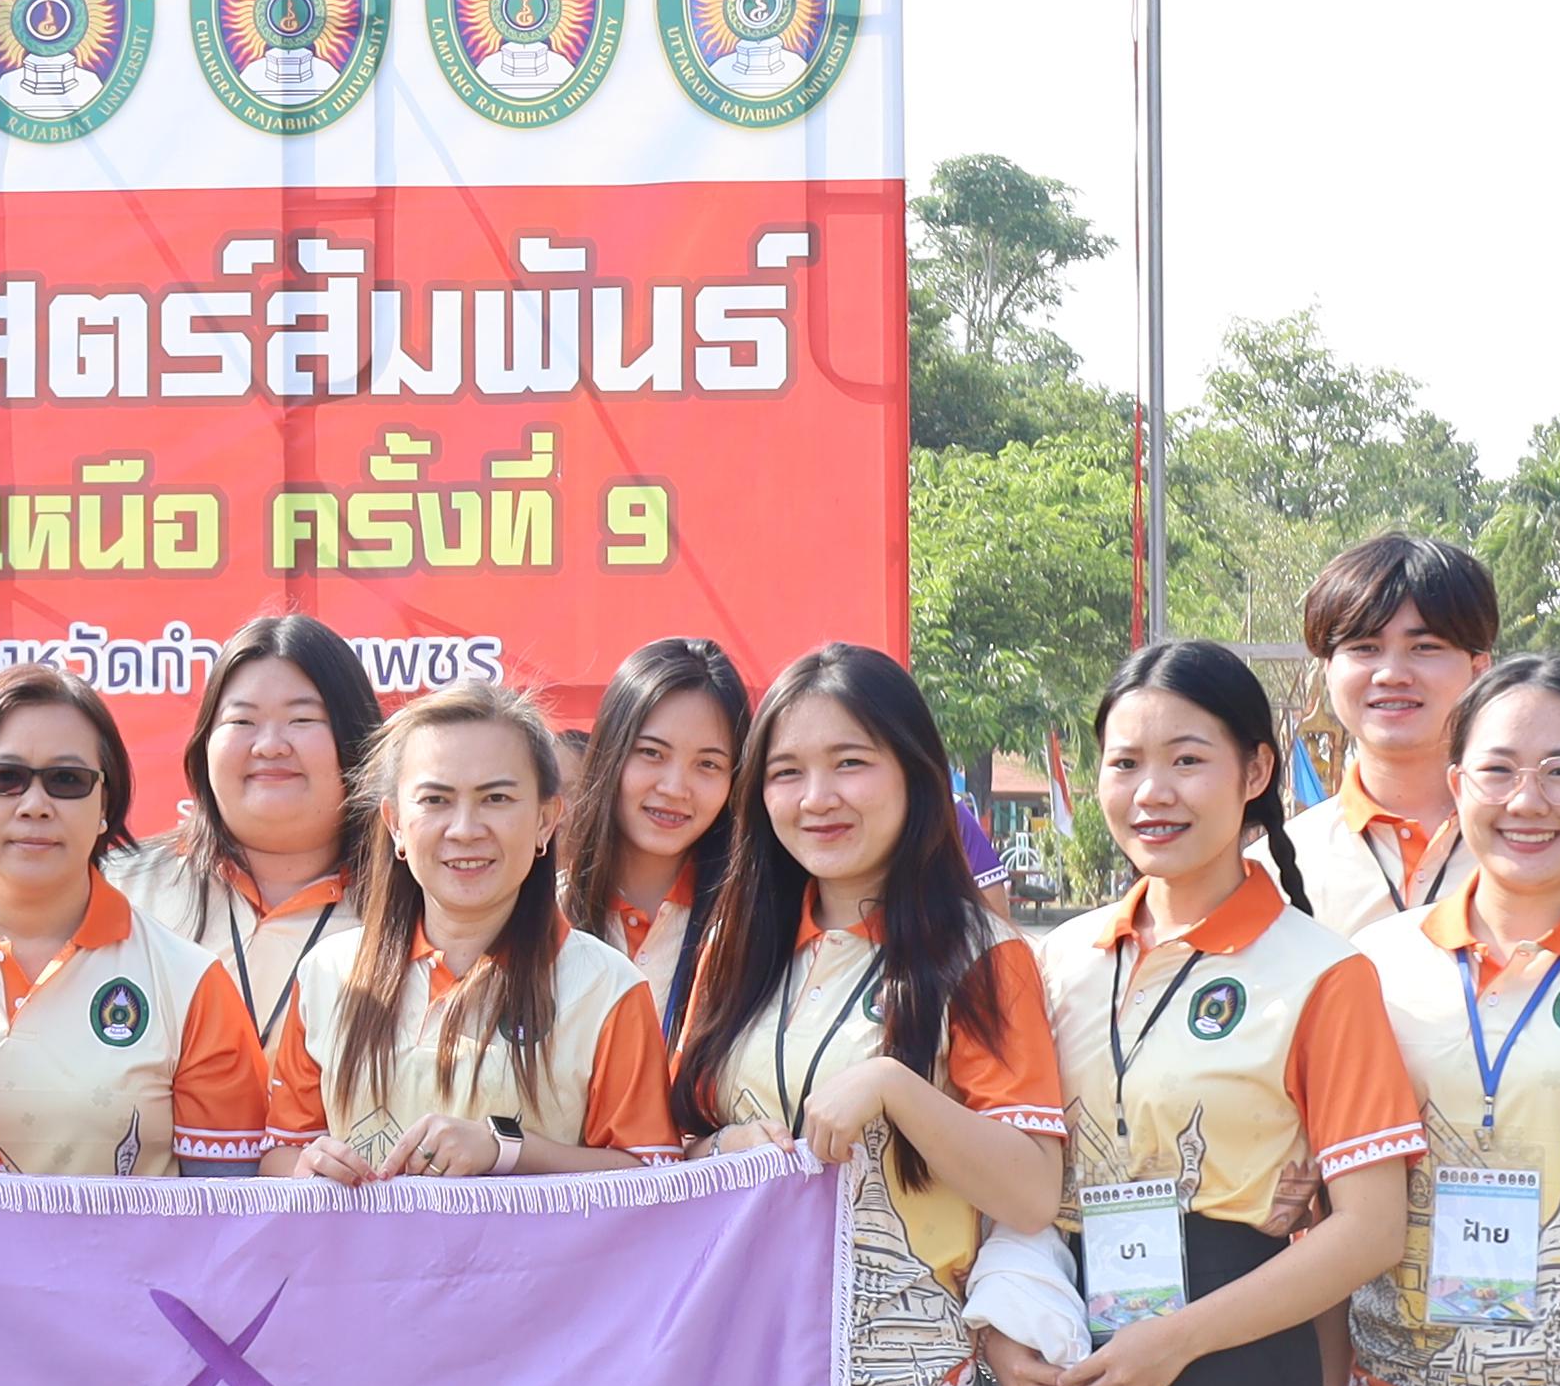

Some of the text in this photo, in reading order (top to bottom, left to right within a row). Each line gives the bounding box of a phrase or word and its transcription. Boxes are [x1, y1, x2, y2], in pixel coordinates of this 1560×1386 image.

[6, 117, 94, 142] RAJABHAT
[99, 26, 150, 117] UNIVERSITY
[195, 16, 385, 131] CHIANGRAI RAJABHAT UNIVERSITY
[432, 17, 618, 123] LAMPANG RAJABHAT UNIVERSITY
[667, 23, 850, 123] UTTARADIT RAJABHAT UNIVERSITY
[272, 431, 554, 568] ครั้งที่
[606, 486, 670, 565] 9
